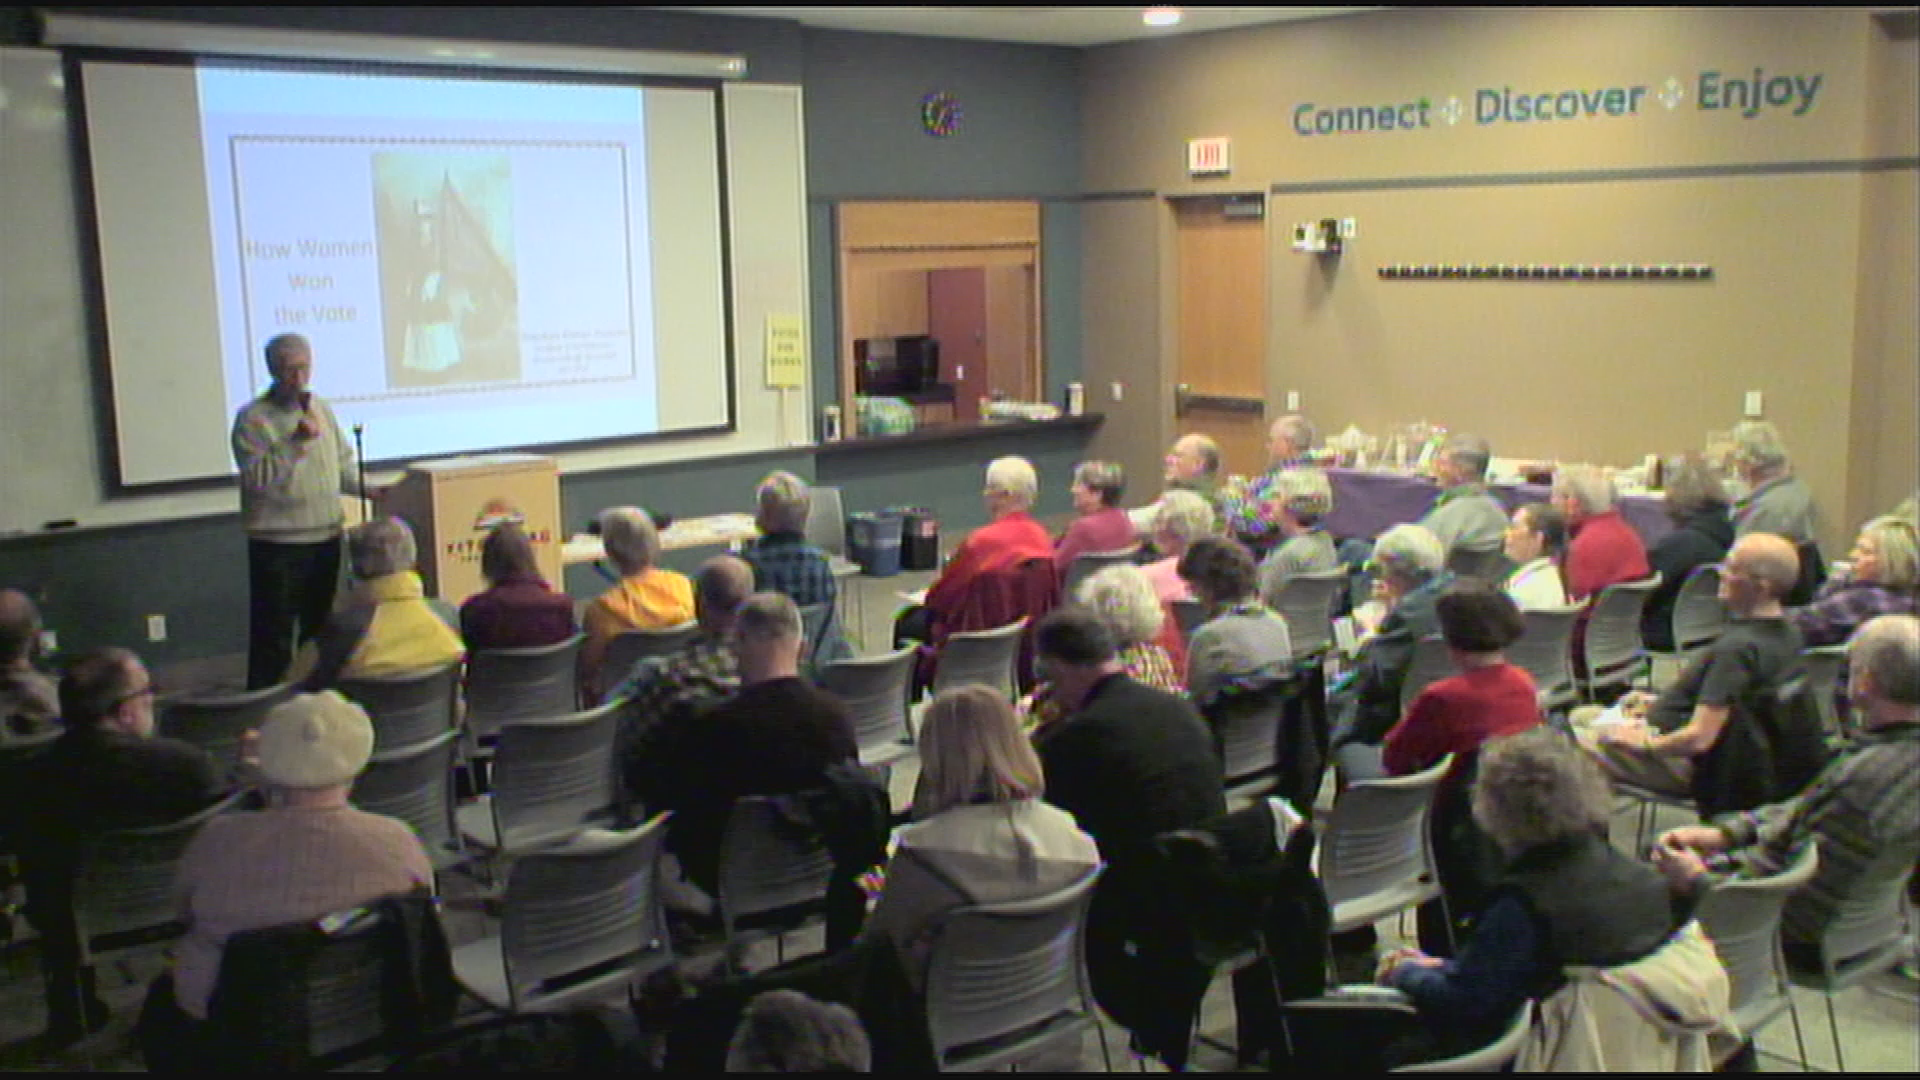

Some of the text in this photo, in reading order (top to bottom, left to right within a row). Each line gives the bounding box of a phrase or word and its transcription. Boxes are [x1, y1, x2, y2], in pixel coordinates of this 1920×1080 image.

[1293, 66, 1823, 136] Connect Discover Enjoy
[246, 236, 374, 261] How Women
[287, 271, 335, 292] Won
[274, 303, 358, 325] the Vote
